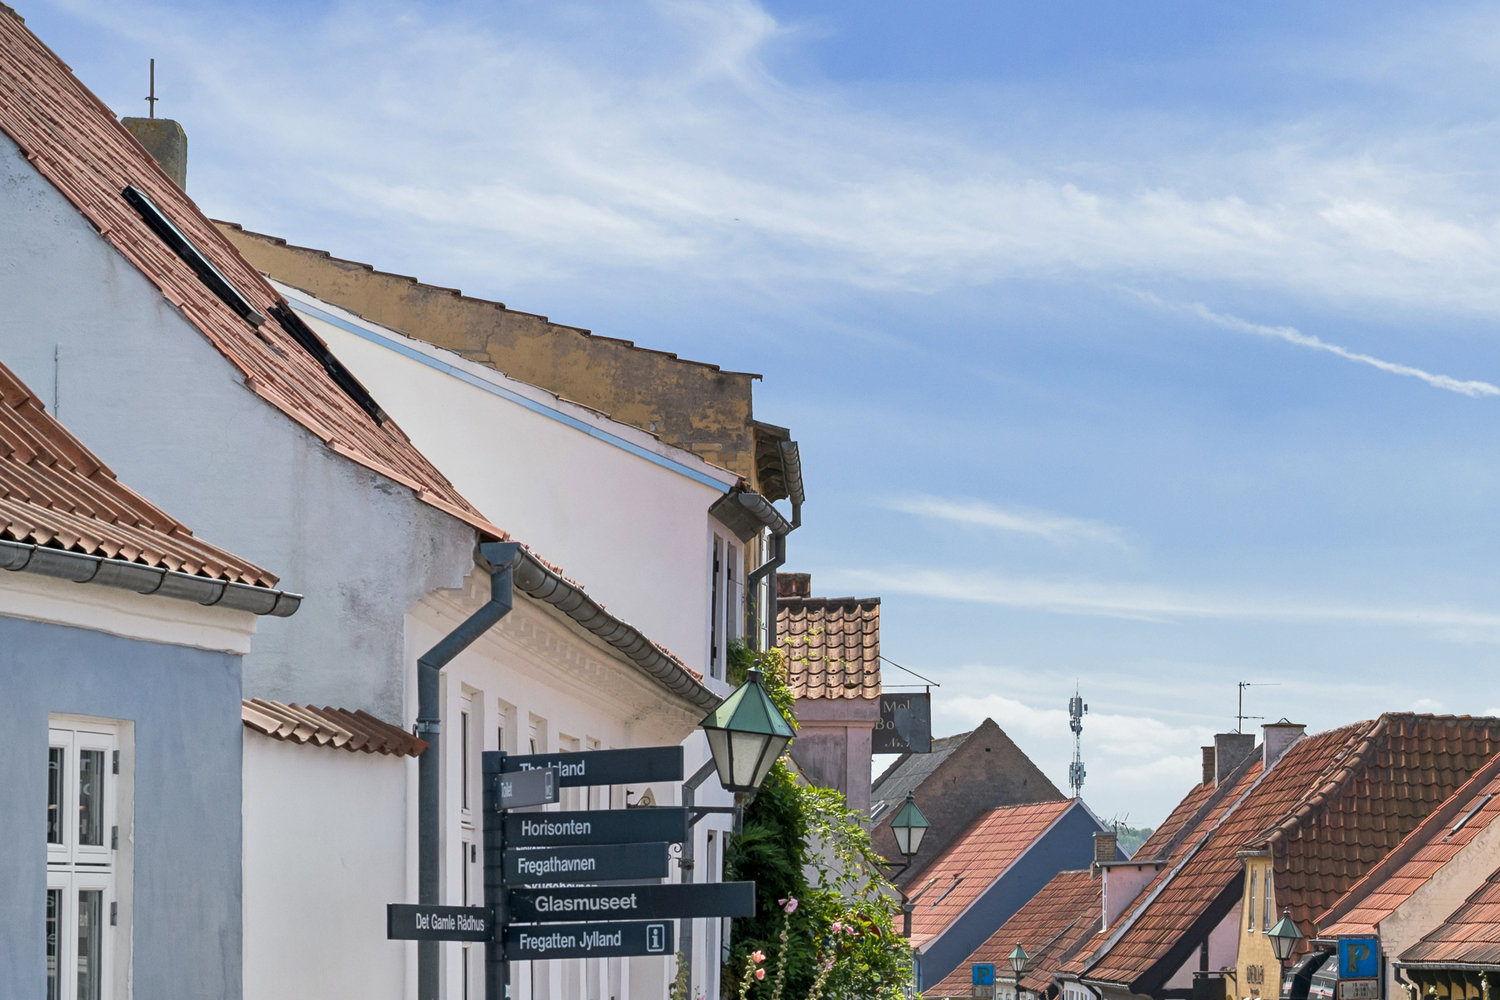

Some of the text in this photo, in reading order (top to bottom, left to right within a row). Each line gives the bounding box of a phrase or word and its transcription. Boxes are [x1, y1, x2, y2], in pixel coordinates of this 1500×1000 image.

[547, 760, 585, 777] land
[521, 819, 591, 836] Horisonten
[518, 856, 596, 876] Fregathavnen
[535, 893, 637, 912] Glasmuseet
[415, 912, 485, 931] Det Gamle Rådhus
[519, 933, 575, 952] Fregatten
[579, 930, 622, 950] Jylland
[1347, 944, 1370, 972] P
